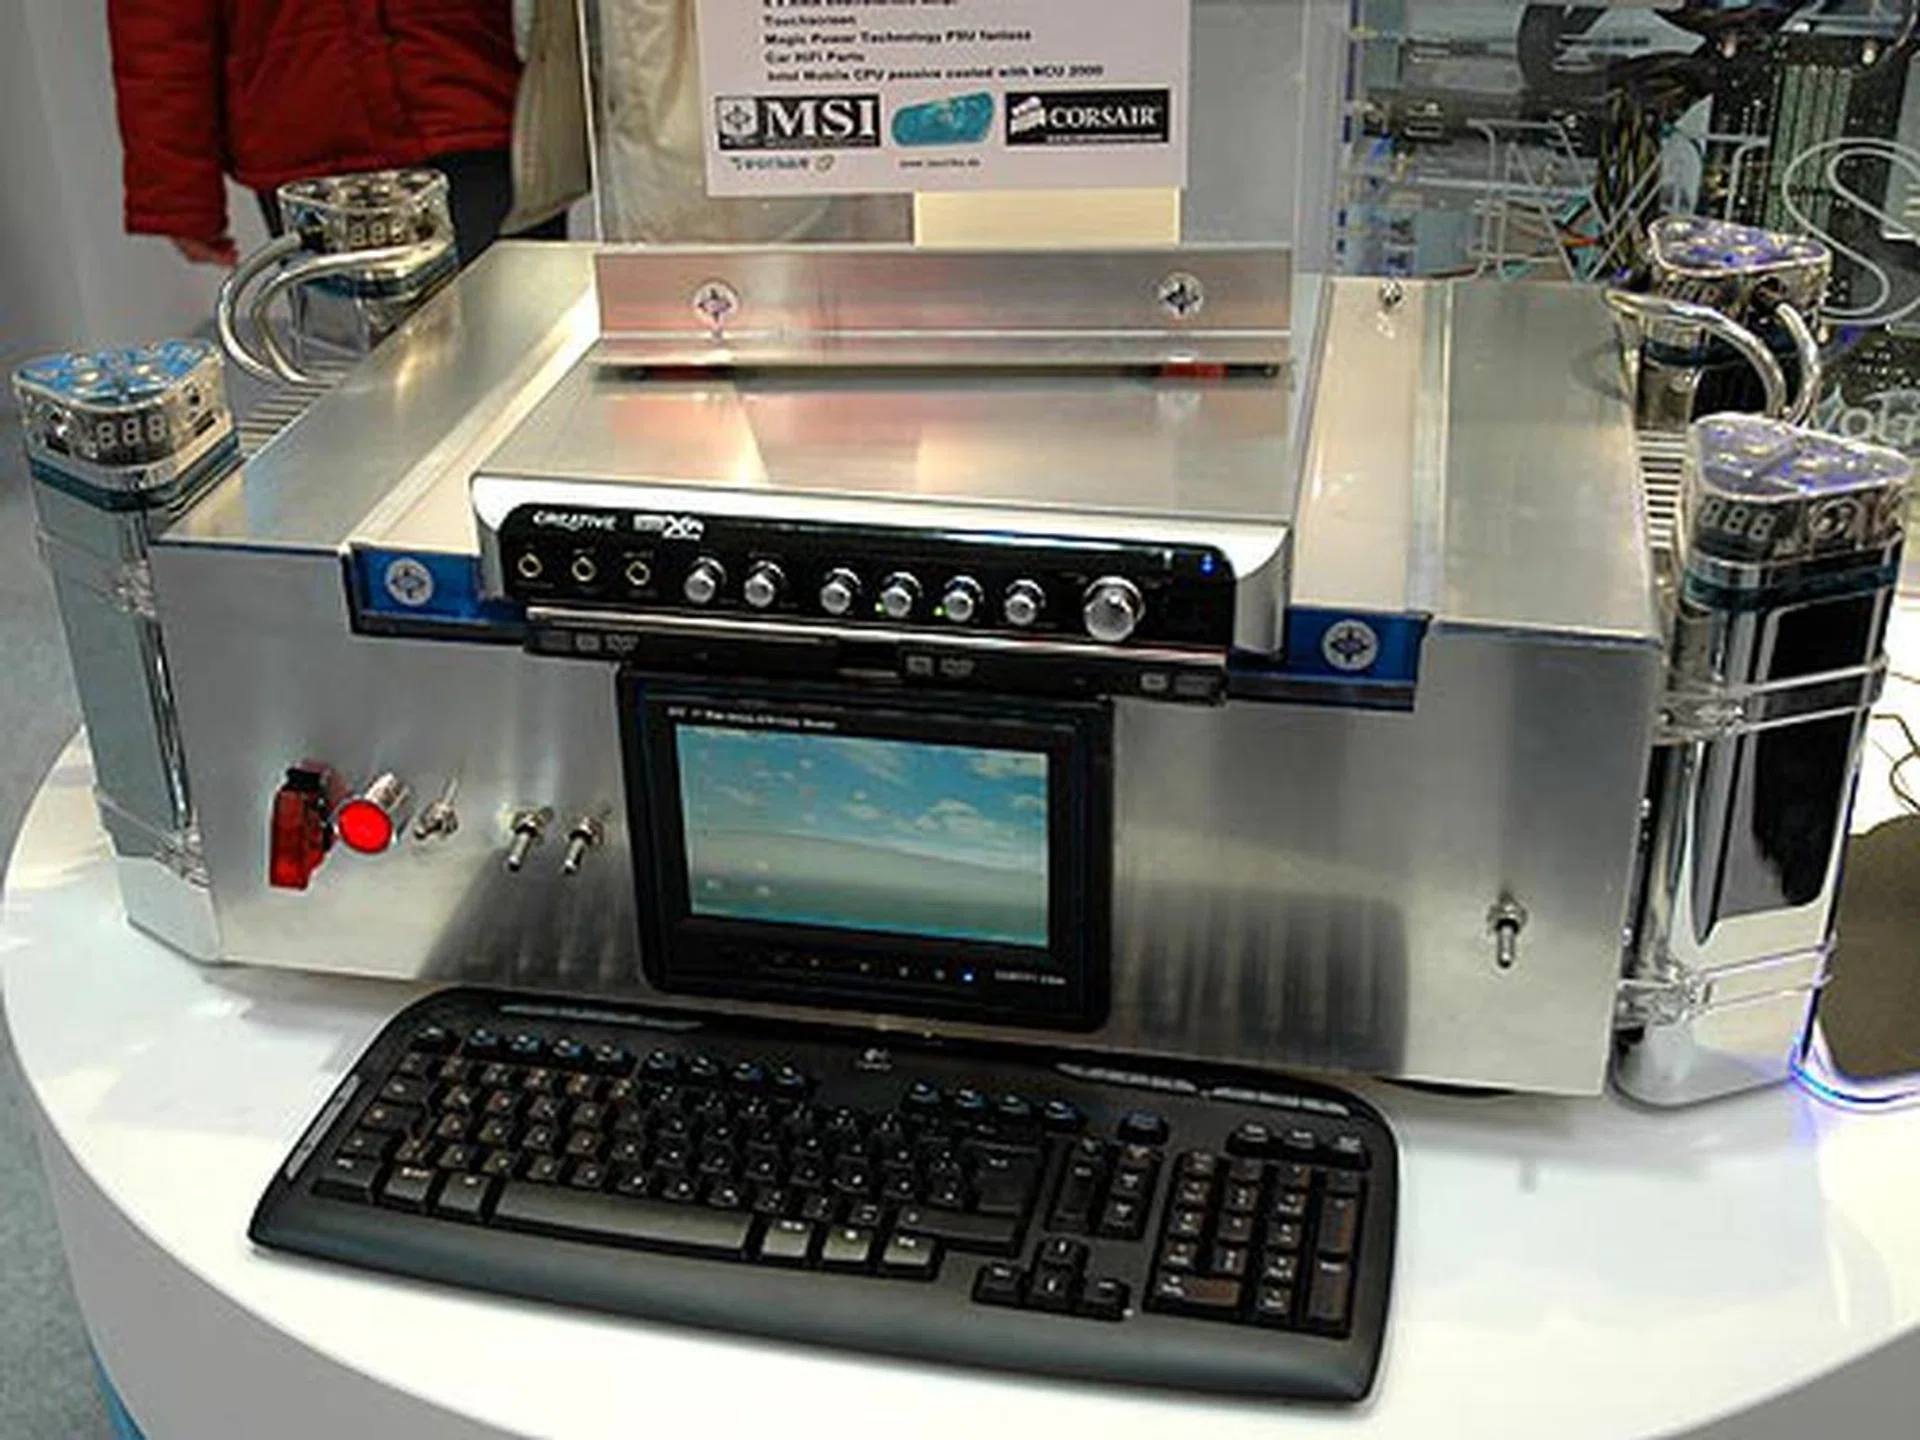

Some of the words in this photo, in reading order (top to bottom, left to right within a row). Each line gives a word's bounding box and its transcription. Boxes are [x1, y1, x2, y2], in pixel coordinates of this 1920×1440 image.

[811, 33, 857, 44] Power
[764, 51, 791, 64] Car
[853, 68, 885, 82] CPU
[765, 99, 876, 137] MSI
[1049, 104, 1158, 129] CORSAIR
